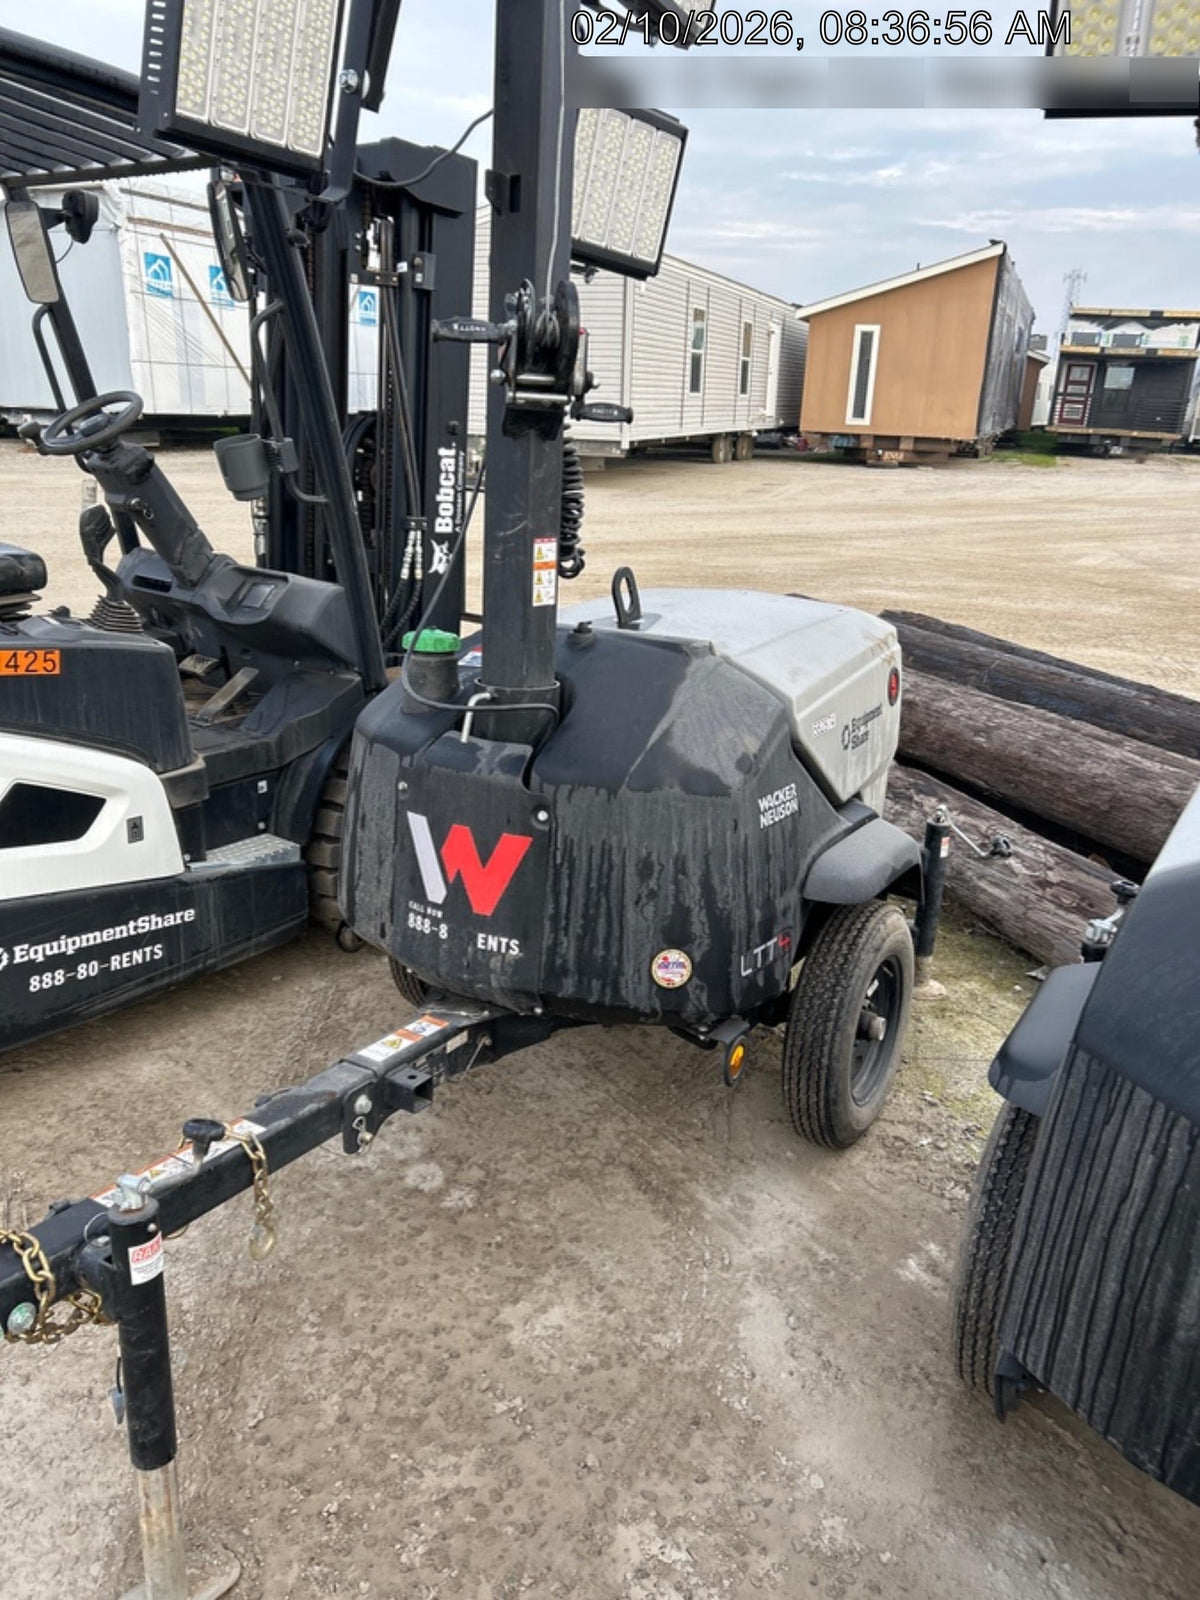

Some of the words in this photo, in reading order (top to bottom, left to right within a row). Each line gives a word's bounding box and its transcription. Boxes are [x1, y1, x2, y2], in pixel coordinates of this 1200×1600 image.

[4, 650, 57, 673] 425
[758, 782, 797, 812] WACKER
[760, 798, 799, 829] NEUSON
[12, 908, 196, 964] EquipmentShare
[28, 943, 164, 993] 888-80-RENTS
